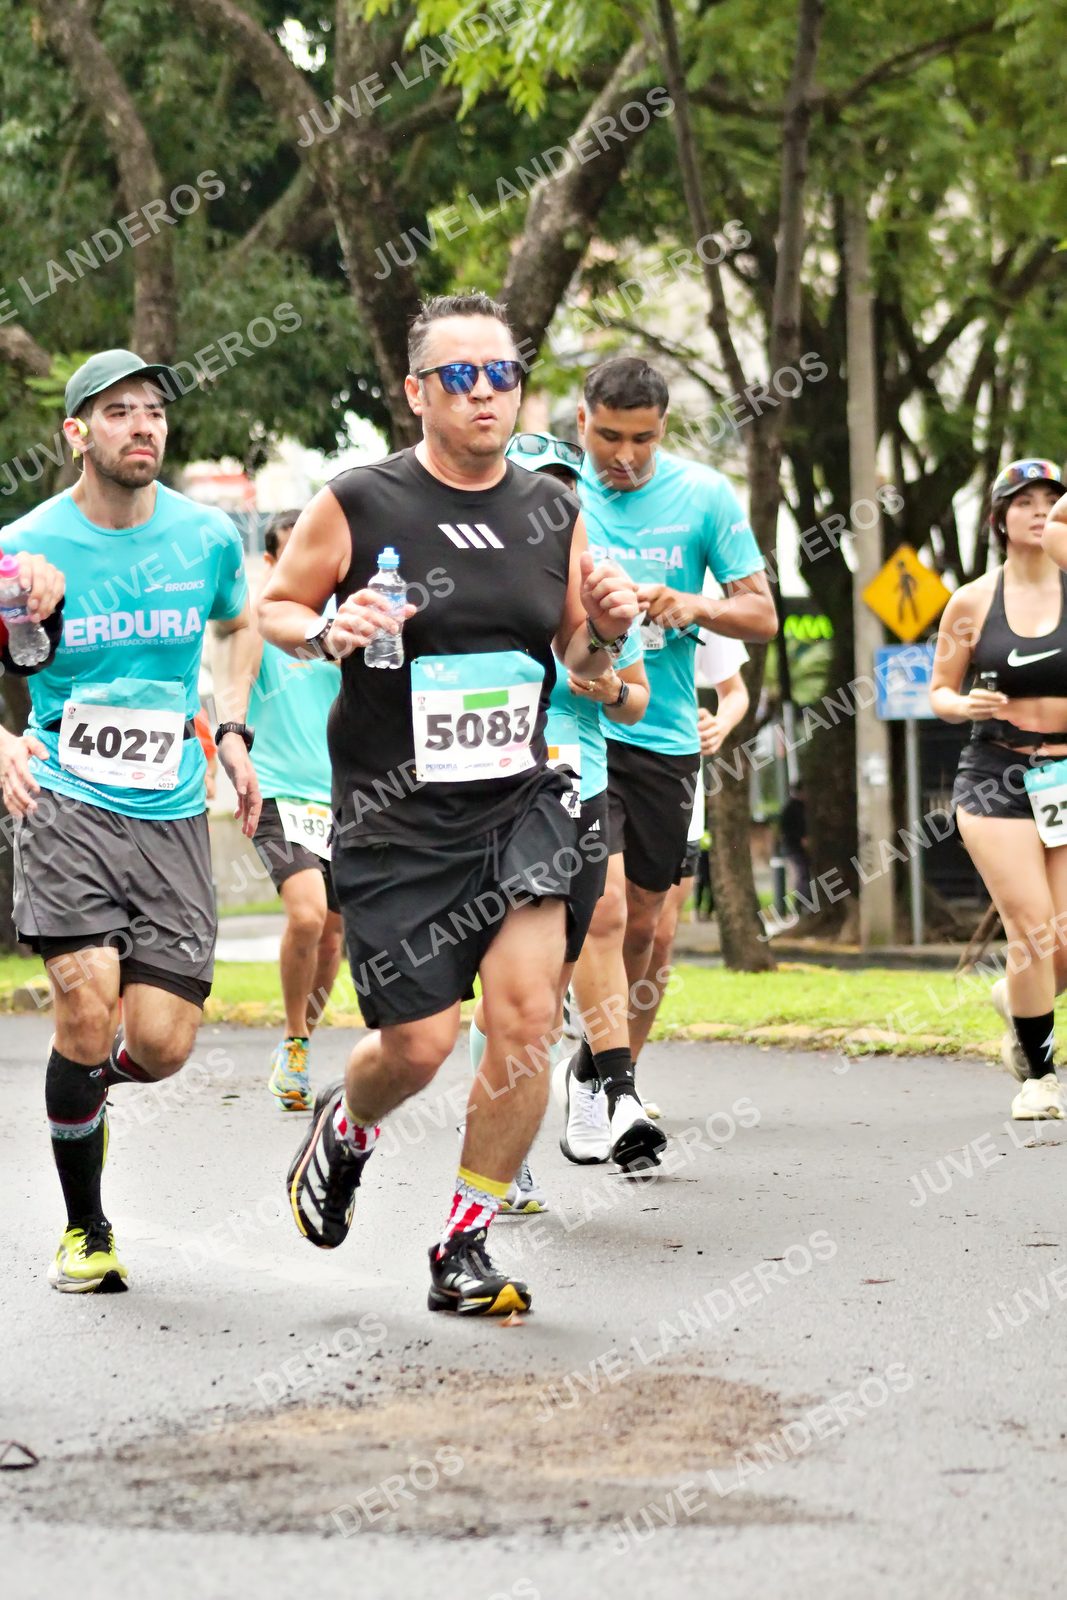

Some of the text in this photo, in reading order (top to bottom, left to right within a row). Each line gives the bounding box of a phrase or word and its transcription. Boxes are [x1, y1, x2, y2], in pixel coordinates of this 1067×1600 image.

[164, 579, 206, 593] BROOKS
[62, 606, 203, 648] ERDURA
[68, 722, 176, 765] 4027
[424, 705, 531, 752] 5083
